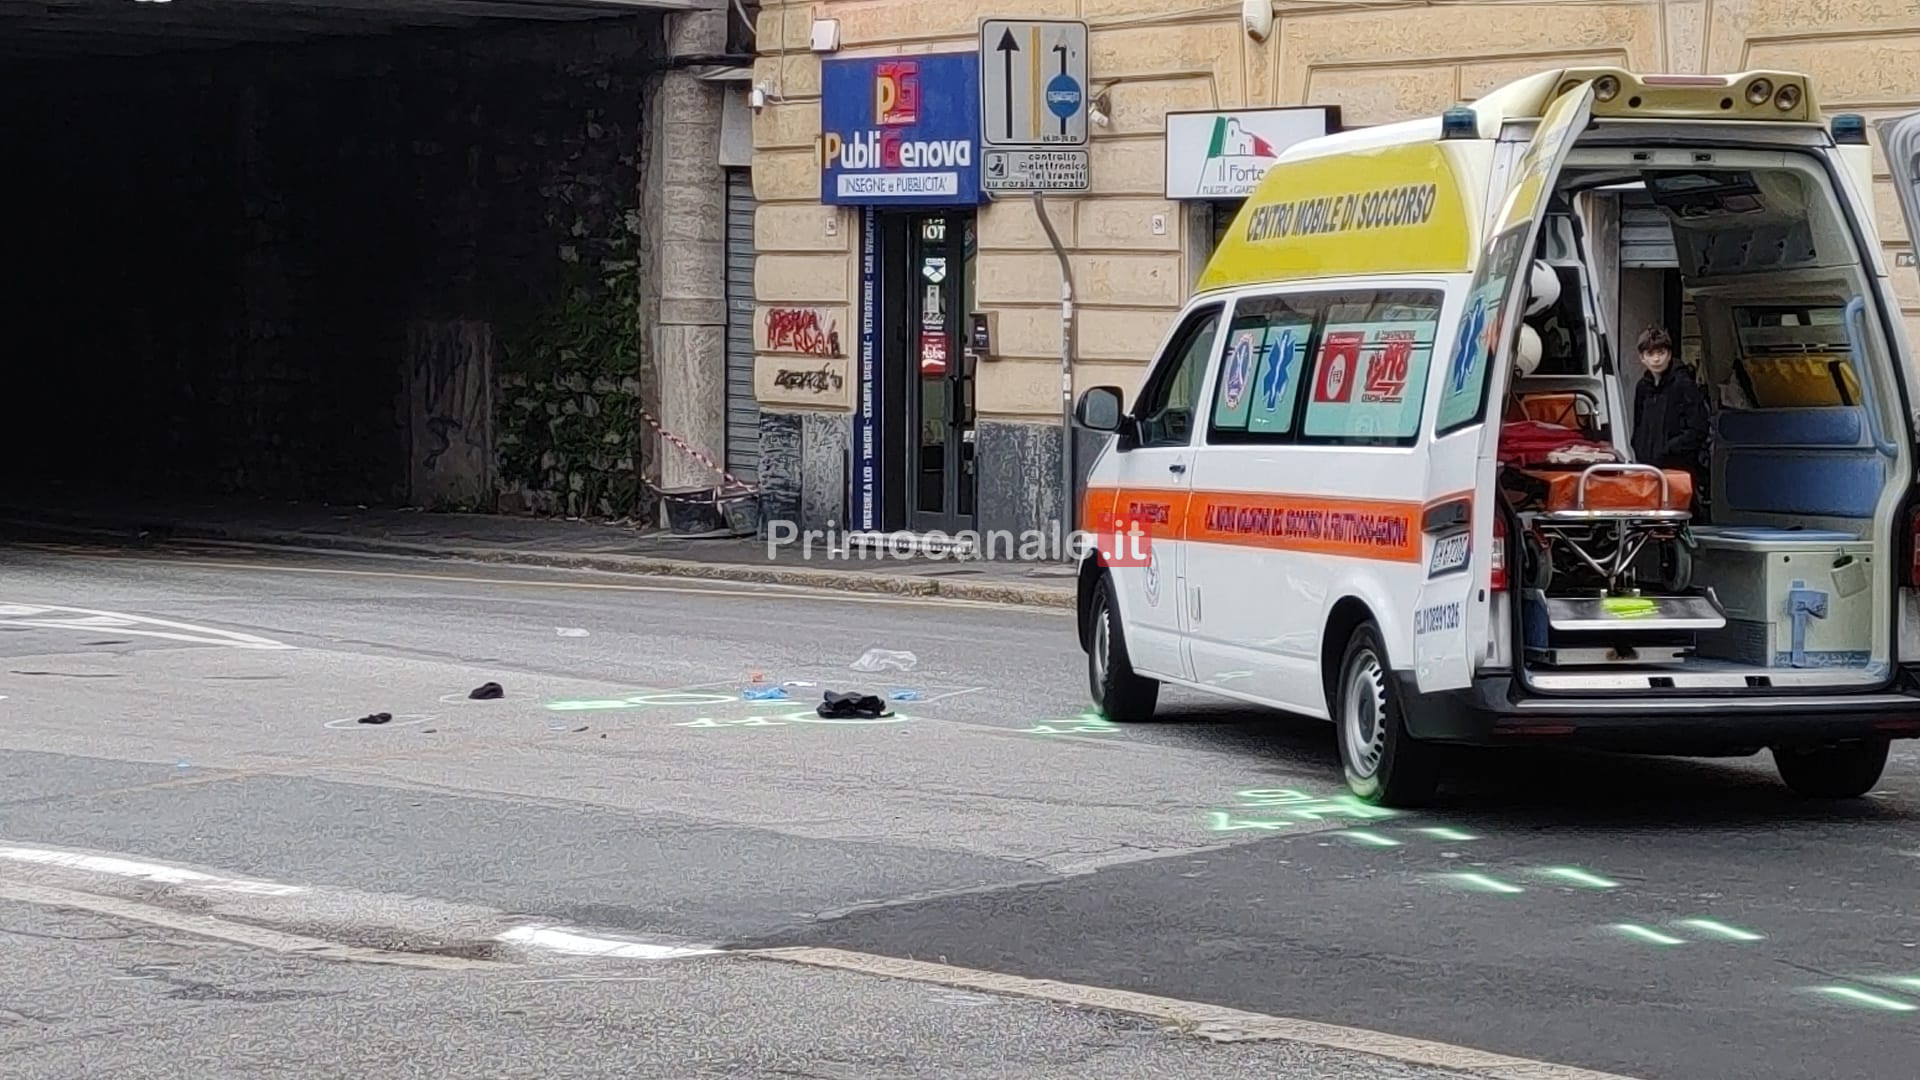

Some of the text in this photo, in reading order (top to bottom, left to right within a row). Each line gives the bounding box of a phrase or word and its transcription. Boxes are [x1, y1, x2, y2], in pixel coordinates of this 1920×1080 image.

[825, 131, 971, 168] PubliGenova
[1028, 152, 1077, 161] controllo
[1028, 160, 1088, 170] elettronico
[1219, 159, 1265, 182] Il Forte
[1048, 170, 1087, 179] transiti
[845, 178, 885, 193] INSEGNE
[1001, 179, 1034, 188] corsia
[1038, 180, 1086, 188] riservata
[1246, 184, 1436, 242] CENTRO MOBILE DI SOCCORSO
[863, 381, 873, 418] STAMPA
